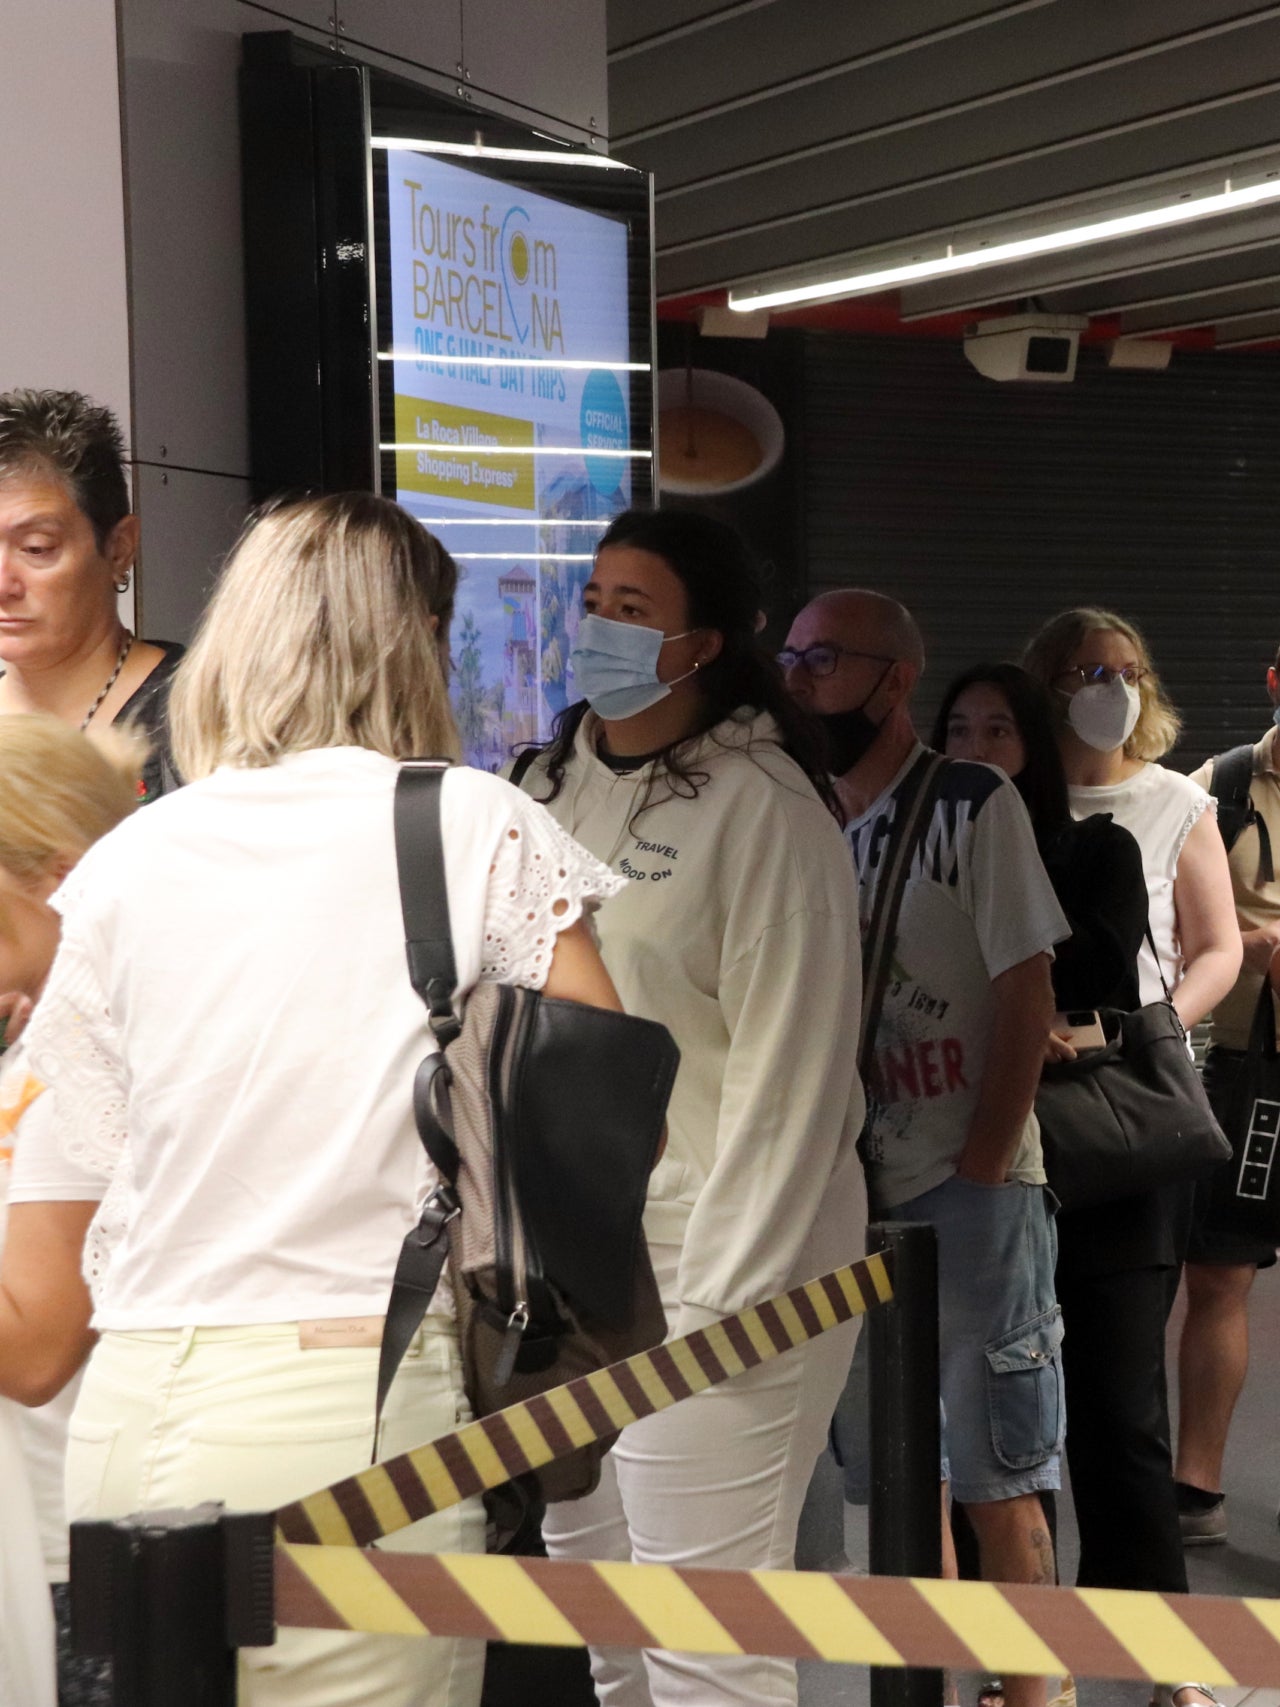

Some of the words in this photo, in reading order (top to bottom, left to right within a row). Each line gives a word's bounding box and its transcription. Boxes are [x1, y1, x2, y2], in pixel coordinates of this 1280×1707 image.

[404, 179, 476, 268] Tours
[415, 326, 444, 376] ONE
[529, 354, 566, 402] TRIPS
[416, 416, 430, 439] La
[431, 419, 460, 445] Roca
[461, 425, 499, 456] Village
[585, 409, 624, 433] OFFICIAL
[587, 433, 623, 450] SERVICE
[416, 449, 470, 485] Shopping
[635, 841, 679, 860] TRAVEL
[619, 858, 646, 881] MOOD
[650, 868, 673, 882] ON
